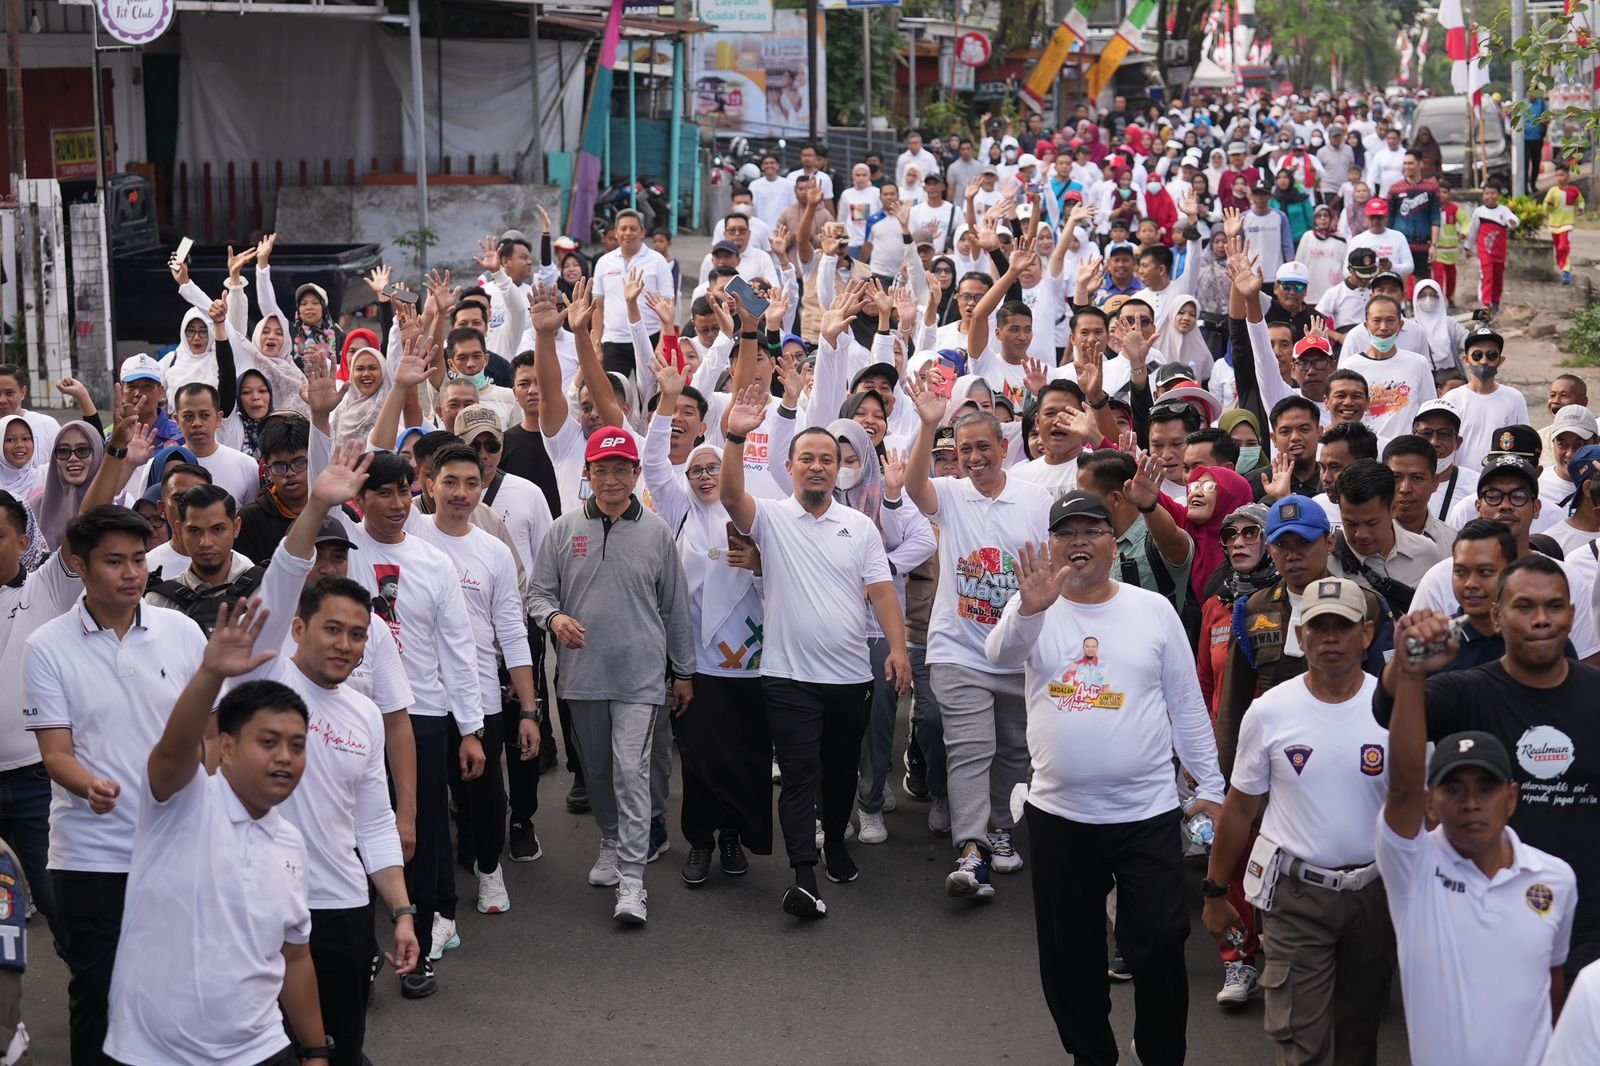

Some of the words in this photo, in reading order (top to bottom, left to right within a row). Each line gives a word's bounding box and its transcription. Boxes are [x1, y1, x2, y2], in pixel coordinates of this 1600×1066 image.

[132, 5, 154, 19] Club
[624, 6, 658, 15] ASABRI
[706, 10, 737, 20] Gadai
[739, 11, 767, 20] Emas
[599, 437, 626, 449] BP
[746, 432, 769, 444] NTI
[743, 444, 768, 458] AG
[956, 573, 1019, 609] Mage
[967, 604, 986, 617] Kab.
[1250, 631, 1280, 646] RWAN
[1074, 682, 1101, 701] Anti
[1057, 693, 1095, 711] Mager
[1459, 739, 1475, 752] P
[1521, 742, 1569, 759] Realman
